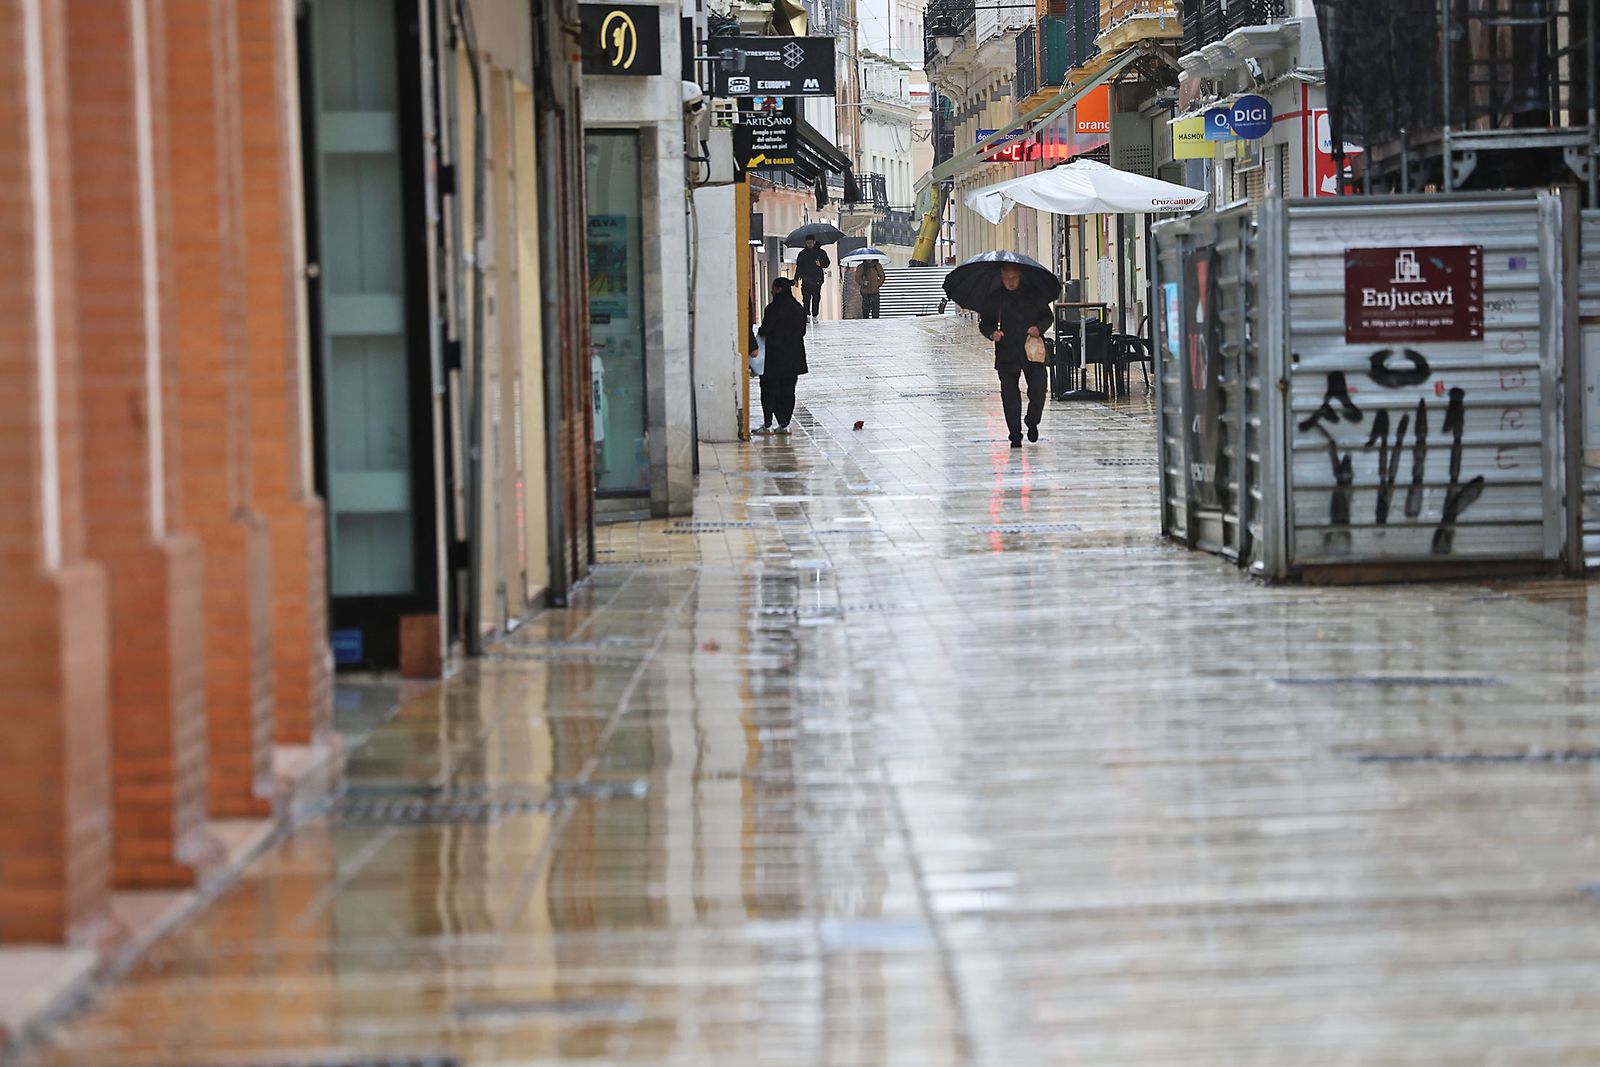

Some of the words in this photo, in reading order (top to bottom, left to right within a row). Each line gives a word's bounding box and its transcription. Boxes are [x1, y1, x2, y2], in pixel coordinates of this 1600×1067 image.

[1234, 109, 1266, 122] DIGI
[1078, 121, 1110, 132] orang
[1151, 198, 1196, 206] Cruzcampo
[1362, 285, 1454, 308] Enjucavi
